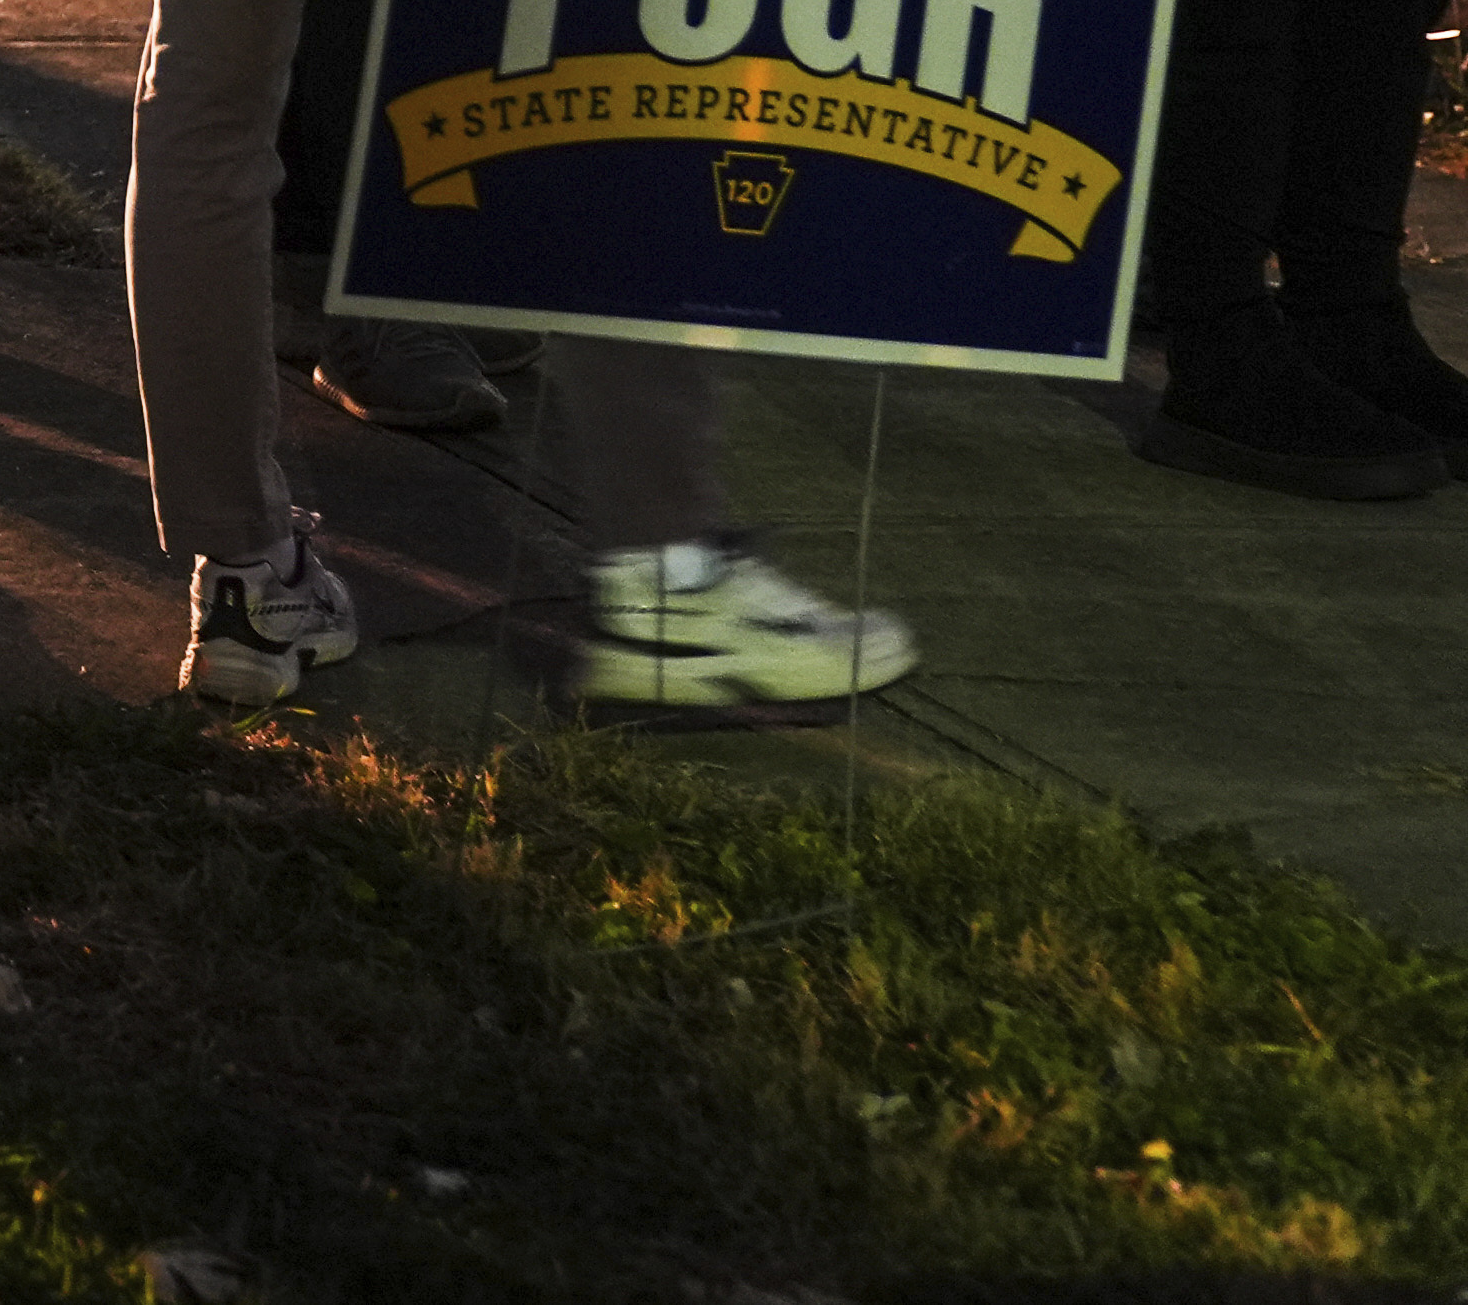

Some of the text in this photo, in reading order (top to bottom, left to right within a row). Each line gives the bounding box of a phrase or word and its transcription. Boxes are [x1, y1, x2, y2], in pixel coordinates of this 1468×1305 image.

[462, 83, 1047, 190] STATE REPRESENTATIVE
[725, 177, 775, 206] 120
